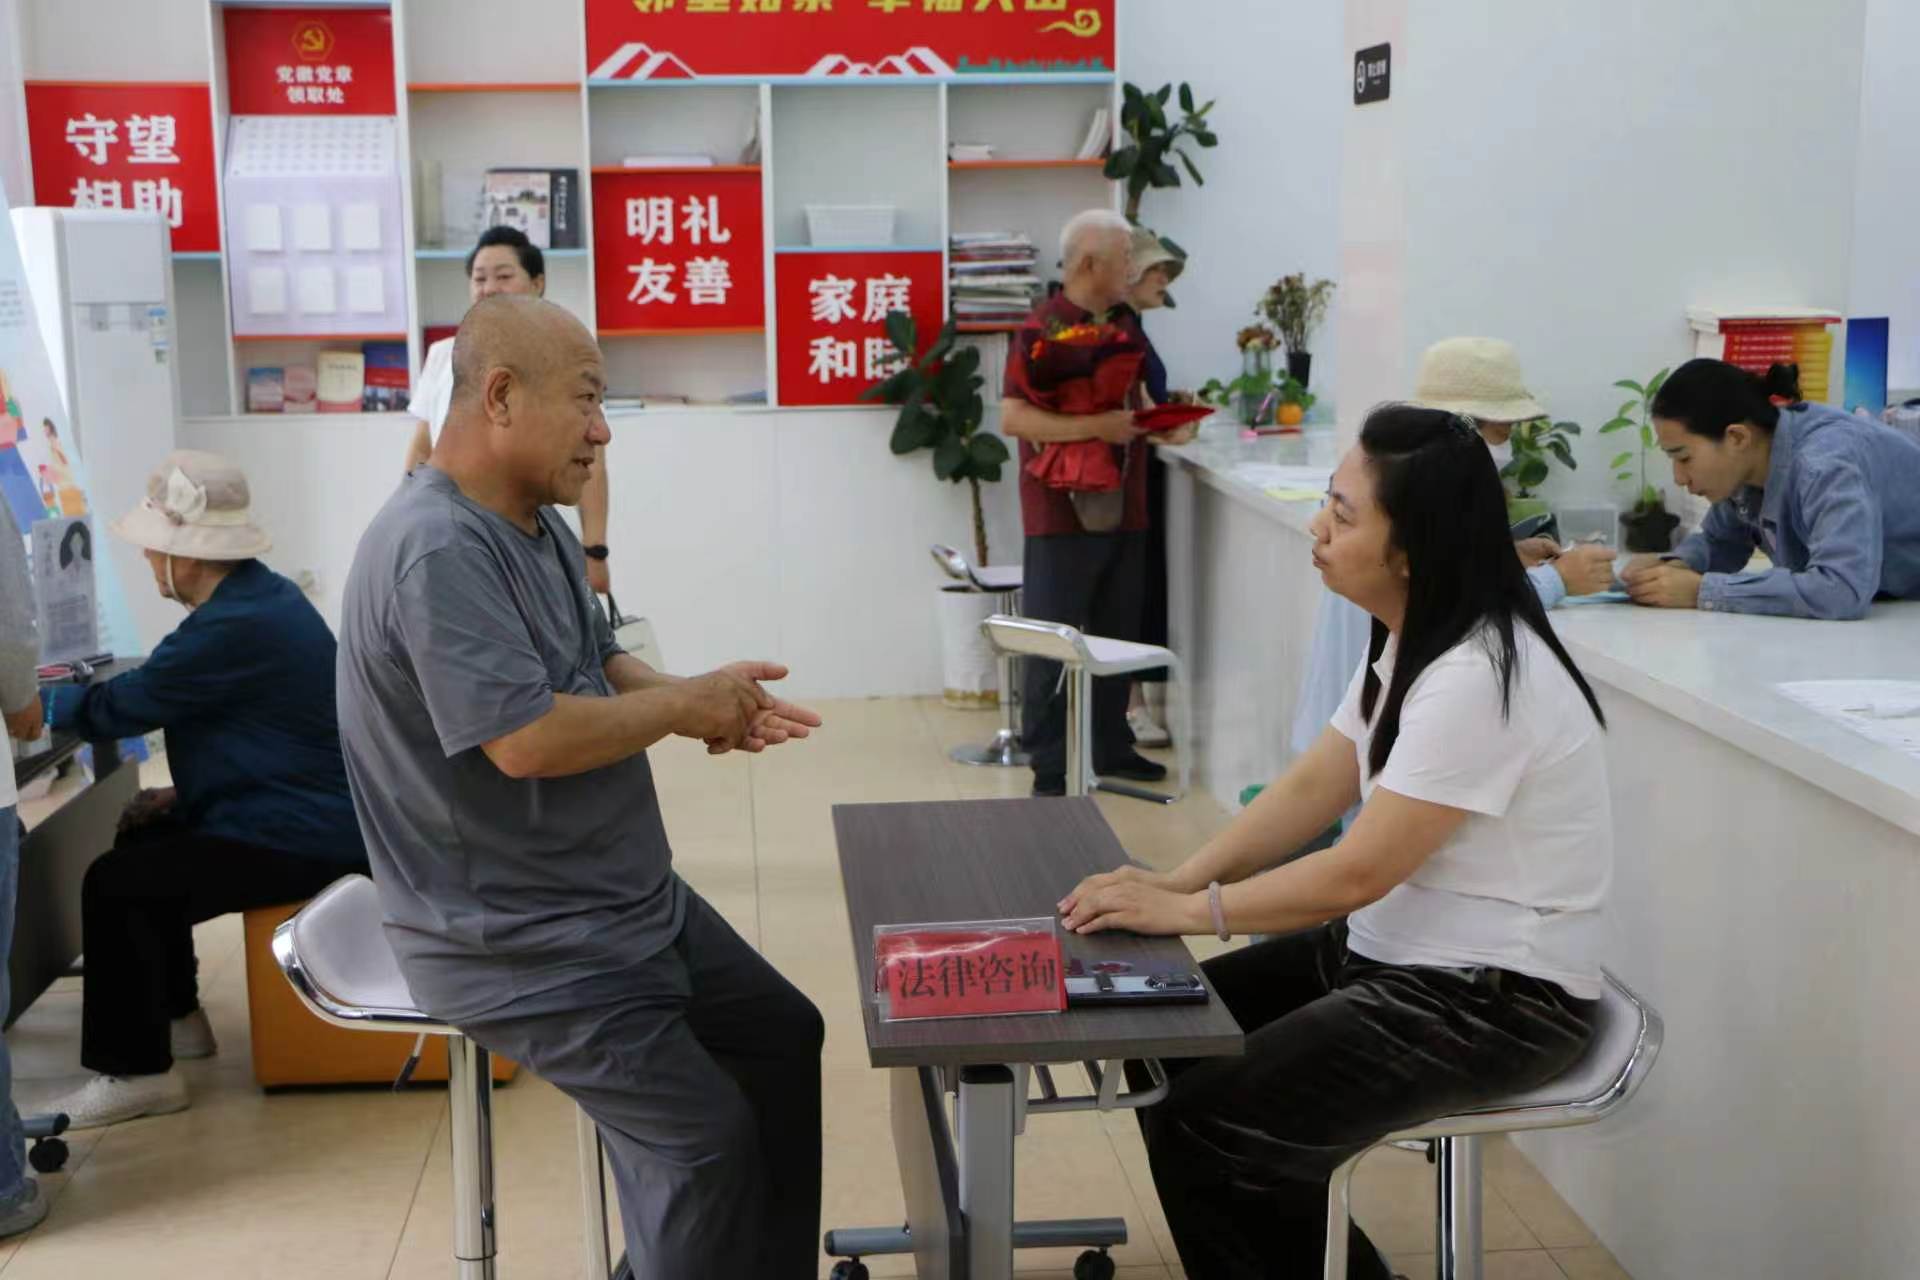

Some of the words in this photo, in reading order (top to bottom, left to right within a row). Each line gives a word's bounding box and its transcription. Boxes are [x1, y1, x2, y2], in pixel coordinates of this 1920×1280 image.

[65, 112, 181, 165] 守望
[625, 195, 732, 245] 明礼
[626, 255, 733, 305] 友善
[808, 272, 912, 323] 家庭
[898, 951, 1056, 998] 法律咨询
